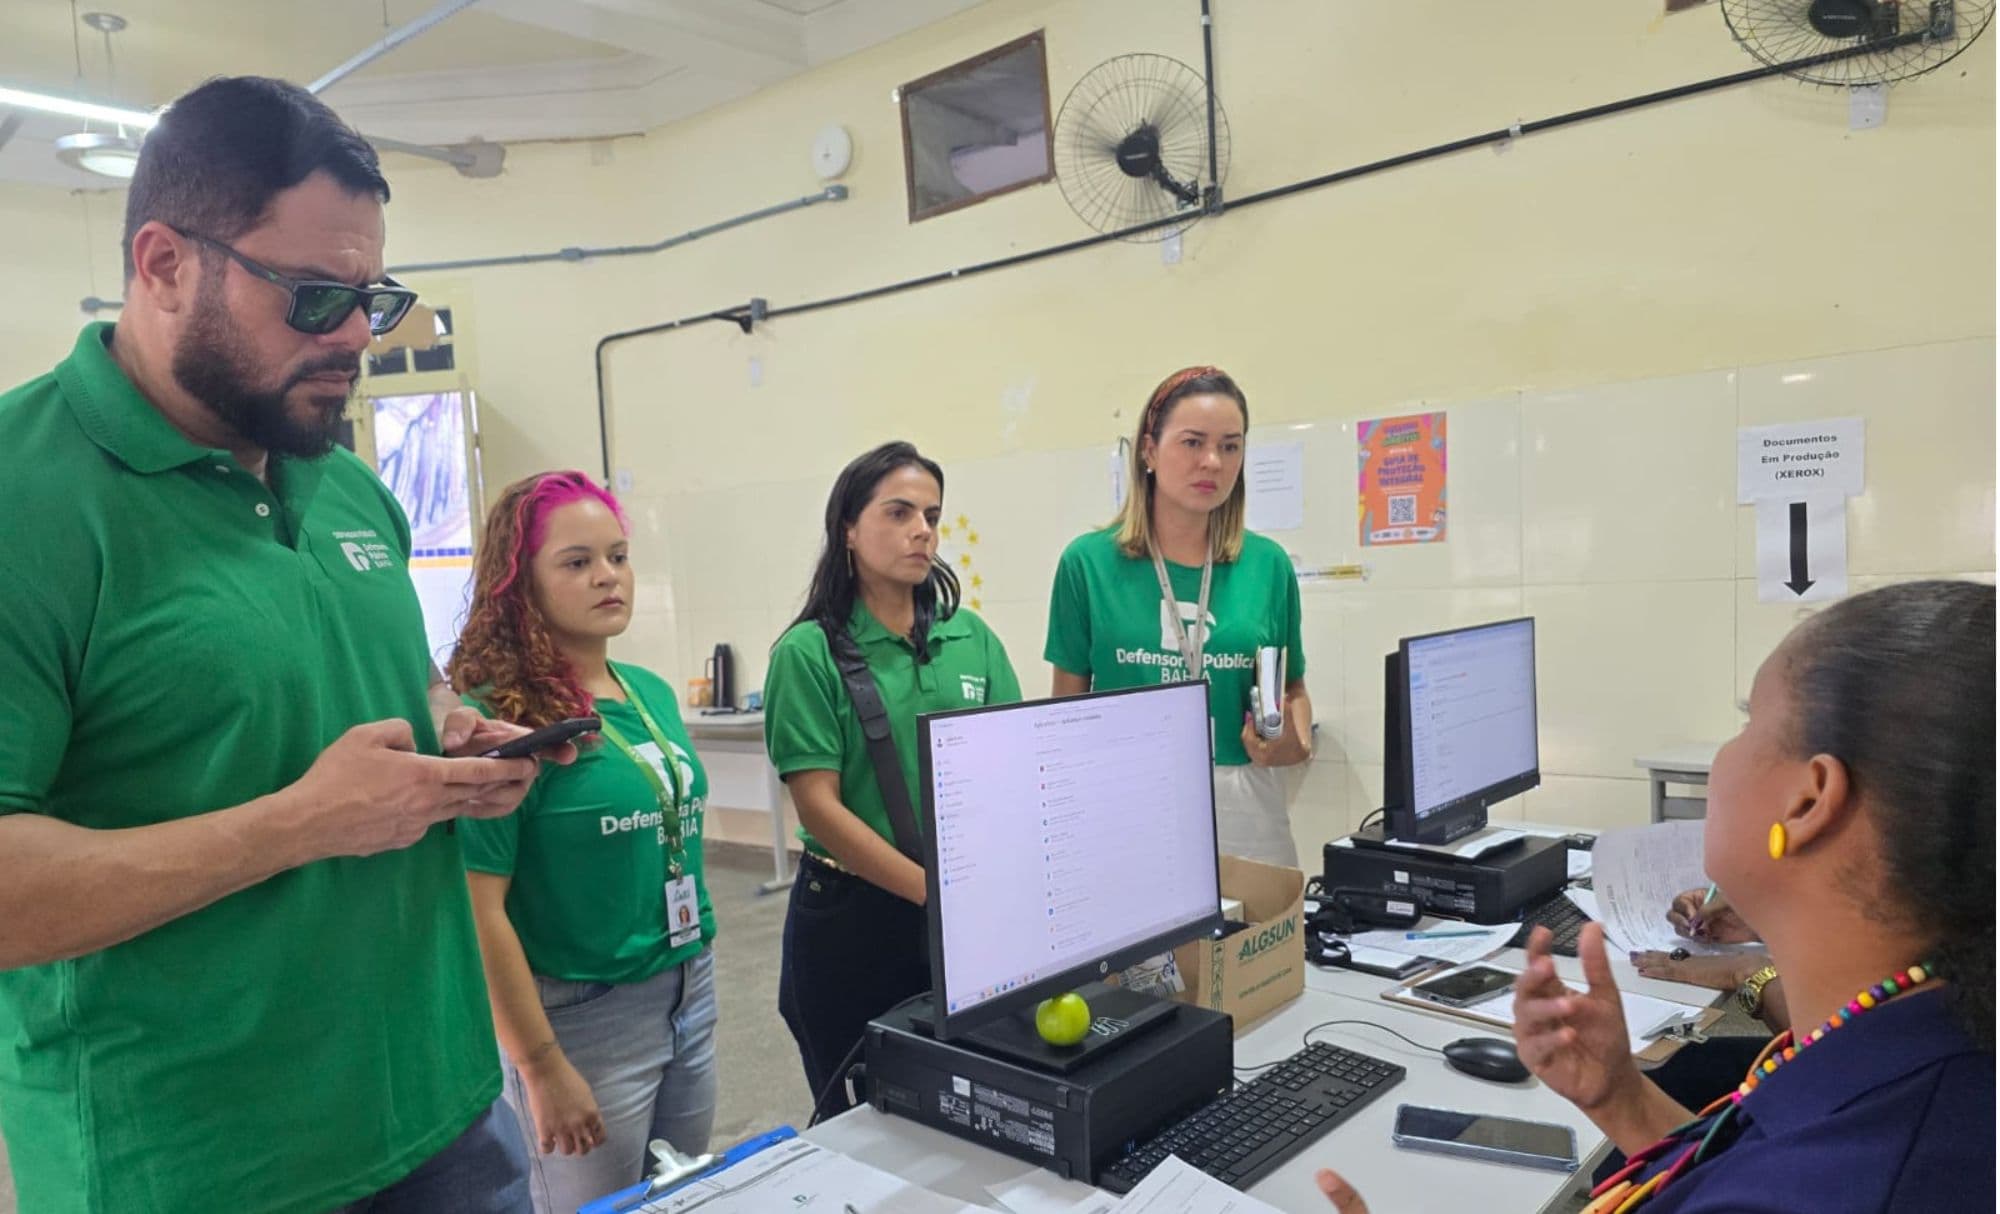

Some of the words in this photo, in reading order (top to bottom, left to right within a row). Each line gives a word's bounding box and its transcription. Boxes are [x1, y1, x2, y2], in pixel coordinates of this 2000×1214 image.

[1763, 435, 1837, 447] Documentos
[1761, 455, 1779, 464] Em
[1783, 451, 1839, 462] Produção
[1775, 468, 1824, 480] (XEROX)
[1116, 647, 1188, 668] Defensor
[1161, 668, 1212, 685] BAHA
[1238, 914, 1296, 960] ALGSUN
